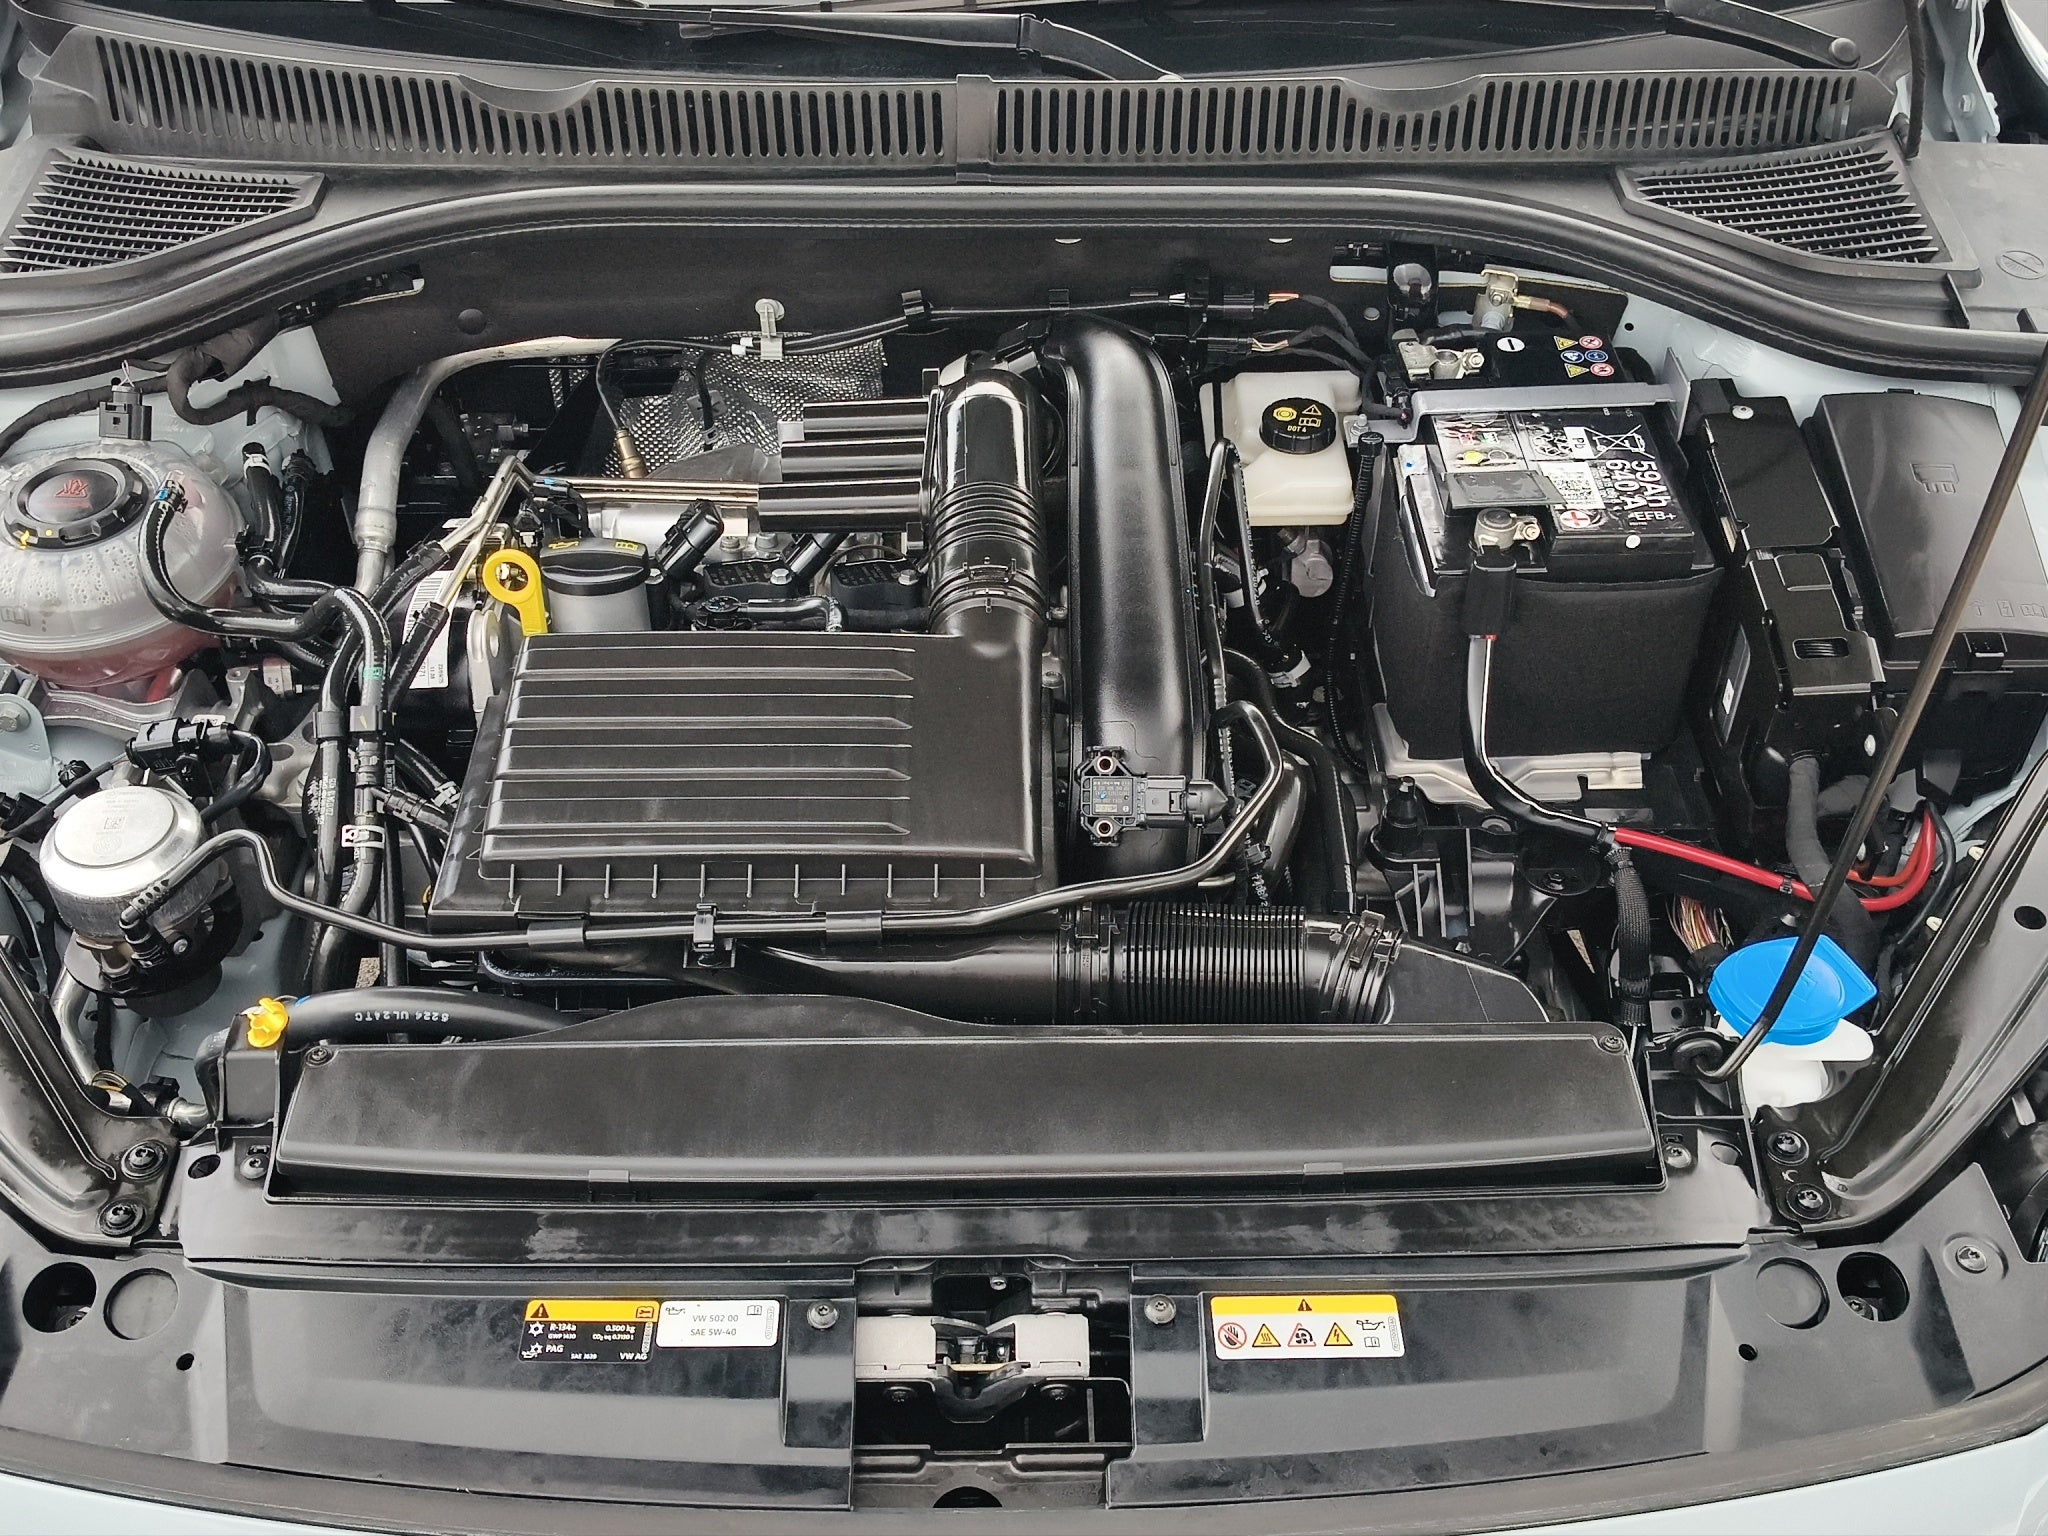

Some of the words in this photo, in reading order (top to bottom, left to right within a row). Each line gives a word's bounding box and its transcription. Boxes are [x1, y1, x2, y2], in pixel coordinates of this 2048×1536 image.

[1572, 437, 1586, 449] Pb
[1606, 459, 1641, 492] 640
[1632, 460, 1671, 508] 59Ah
[1620, 495, 1648, 511] A
[692, 1314, 708, 1323] VW
[710, 1314, 726, 1323] 502
[727, 1314, 739, 1323] 00
[549, 1323, 577, 1332] R-134a
[626, 1324, 636, 1334] kg
[690, 1328, 706, 1336] SAE
[708, 1328, 737, 1336] 5W-40
[545, 1344, 565, 1353] PAG
[620, 1352, 634, 1360] VW
[634, 1352, 648, 1360] AG
